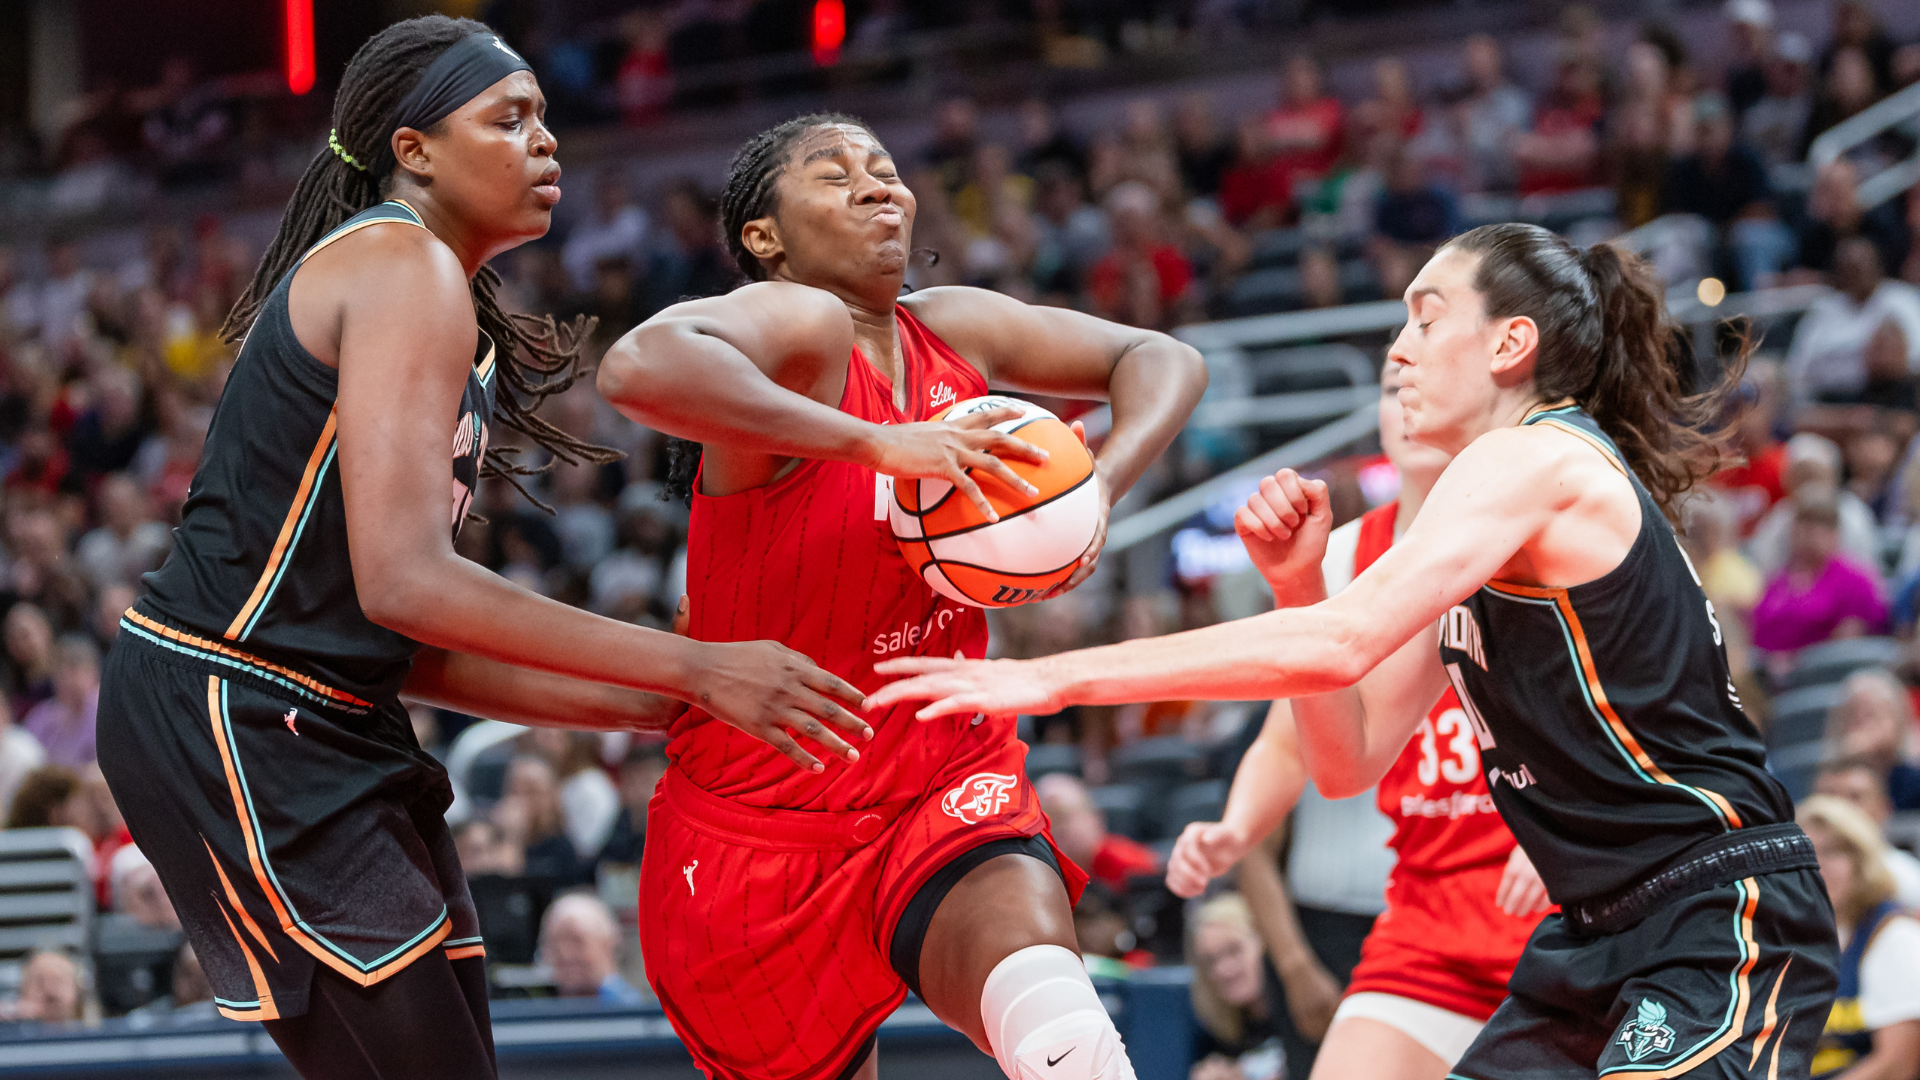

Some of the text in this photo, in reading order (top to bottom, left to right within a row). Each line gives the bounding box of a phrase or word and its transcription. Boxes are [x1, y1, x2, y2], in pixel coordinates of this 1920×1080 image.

[929, 380, 957, 408] Lilly
[990, 578, 1061, 604] Wil
[1415, 707, 1480, 787] 33
